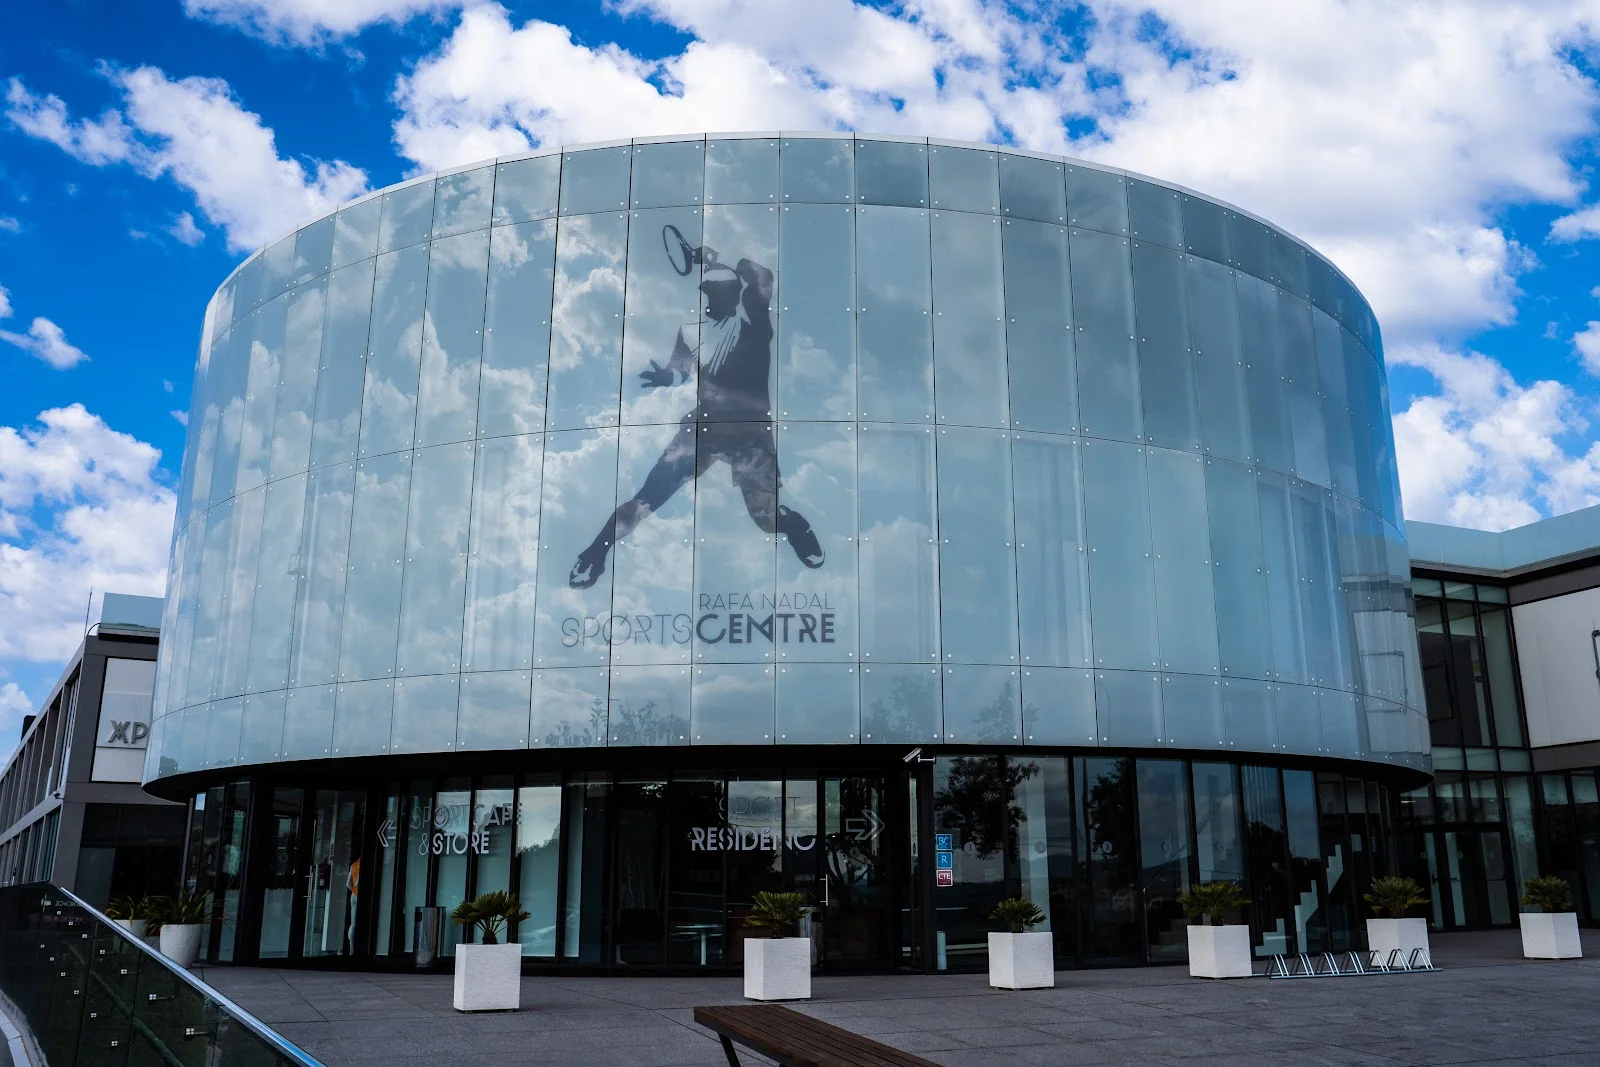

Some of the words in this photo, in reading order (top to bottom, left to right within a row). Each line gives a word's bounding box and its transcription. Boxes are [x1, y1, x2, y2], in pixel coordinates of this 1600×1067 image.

[700, 593, 753, 610] RAFA
[762, 592, 835, 610] NADAL
[411, 804, 470, 829] SPORT
[419, 832, 430, 855] &
[432, 831, 490, 855] STORE
[941, 855, 948, 864] R
[938, 872, 951, 880] CTE
